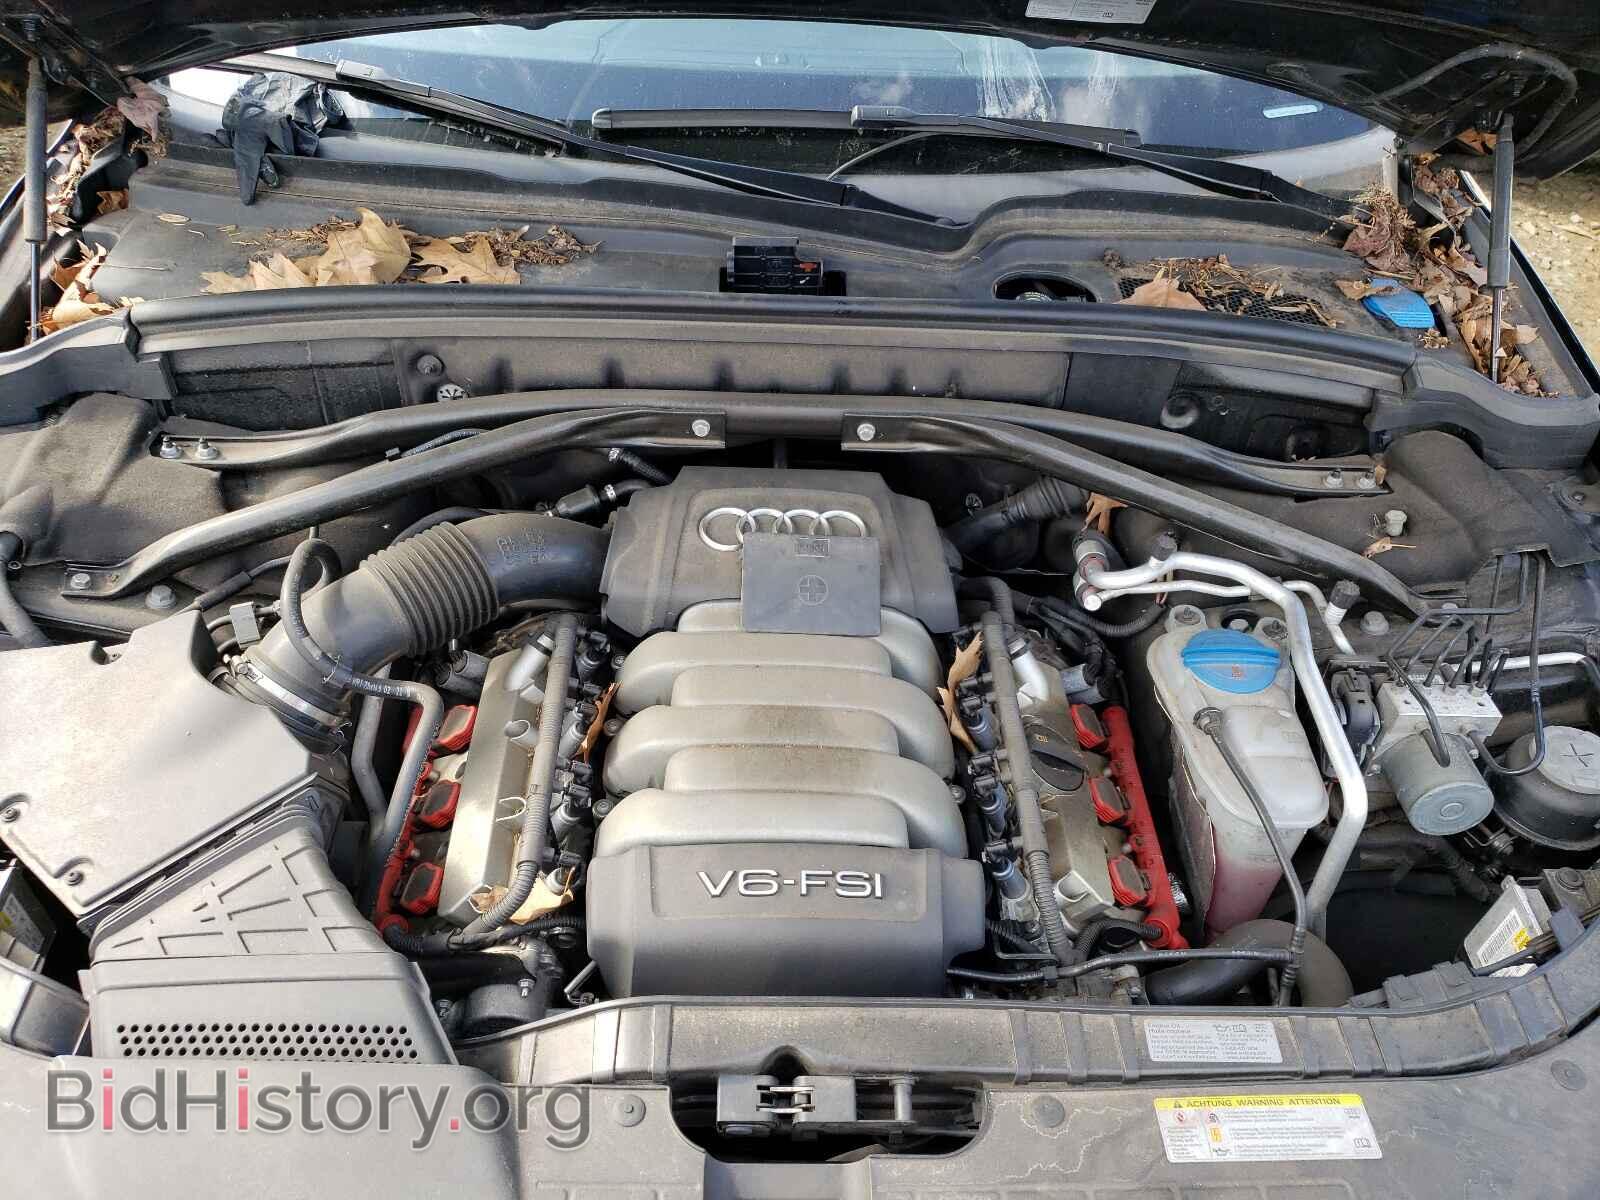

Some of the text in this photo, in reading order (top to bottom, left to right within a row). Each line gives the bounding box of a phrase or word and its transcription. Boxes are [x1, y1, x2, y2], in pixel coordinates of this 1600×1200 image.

[697, 869, 884, 899] V6-FSI
[1186, 1097, 1341, 1108] ACHTUNG WARNING ATTENTION
